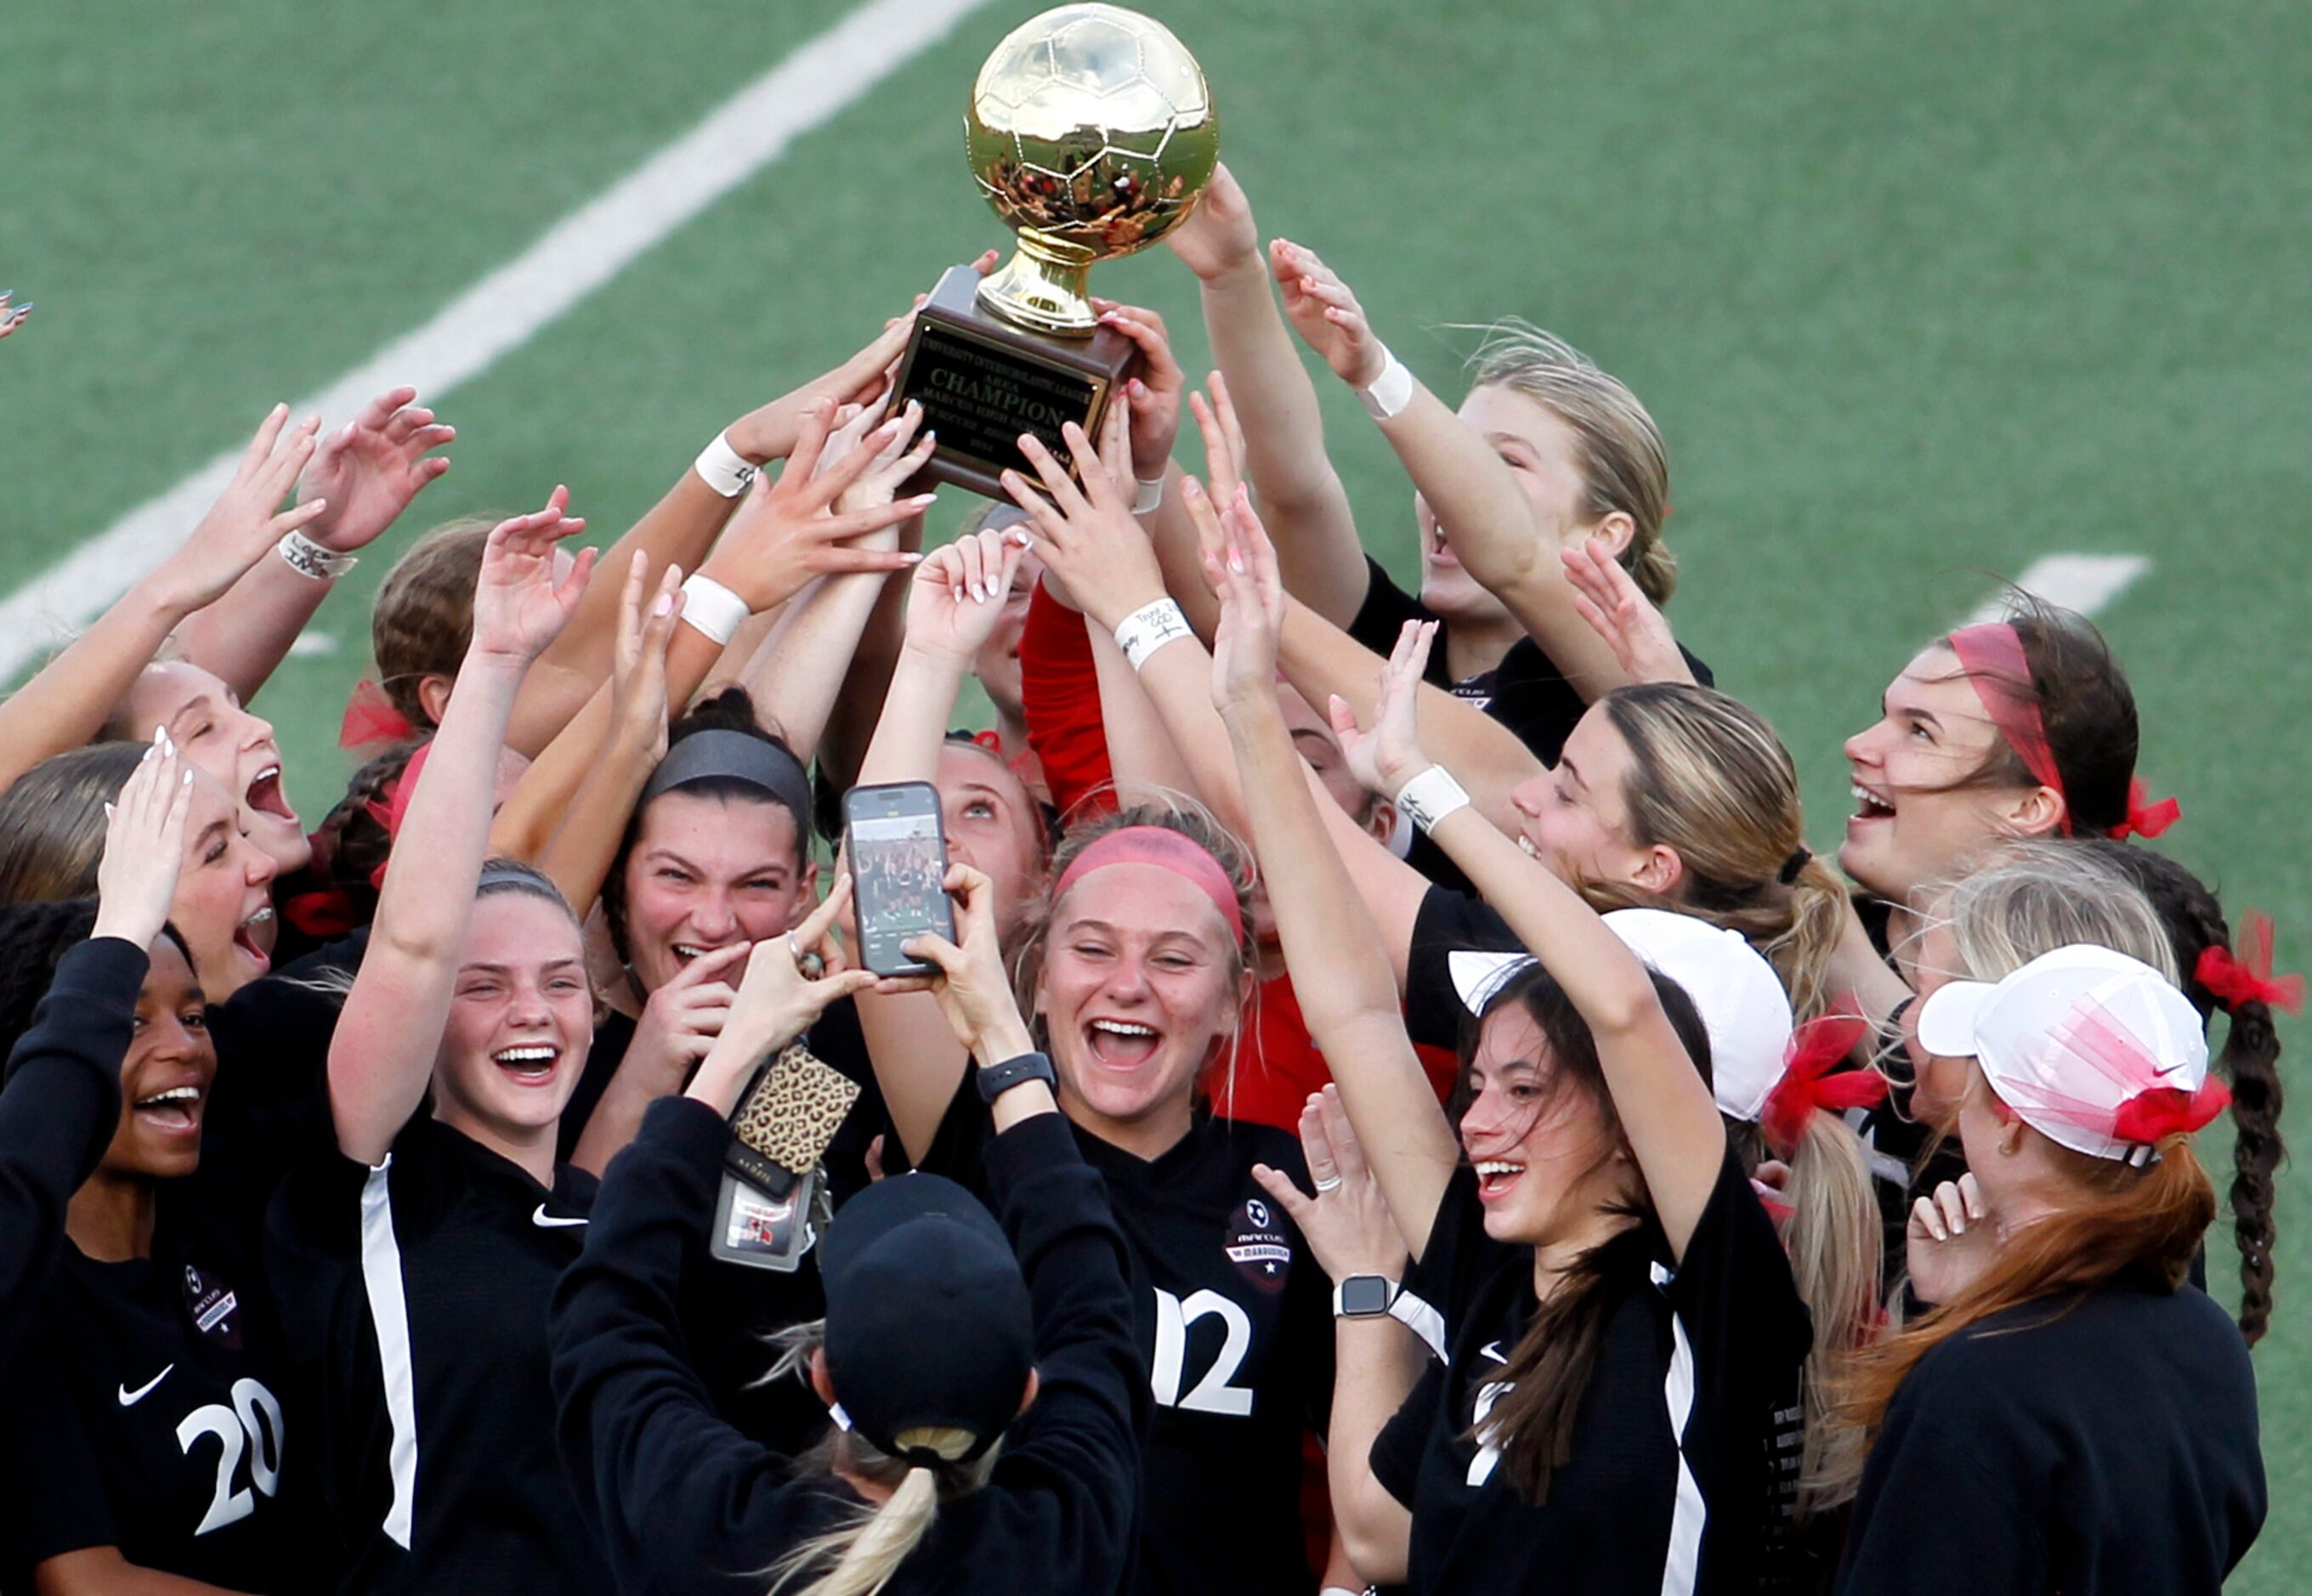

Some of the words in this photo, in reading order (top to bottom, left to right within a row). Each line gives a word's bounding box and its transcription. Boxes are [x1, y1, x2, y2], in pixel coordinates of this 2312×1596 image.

[922, 386, 975, 412] MARCUS
[977, 403, 1009, 423] HIGH
[930, 367, 1066, 427] CHAMPION
[1150, 1287, 1254, 1417] 12
[175, 1377, 285, 1537] 20
